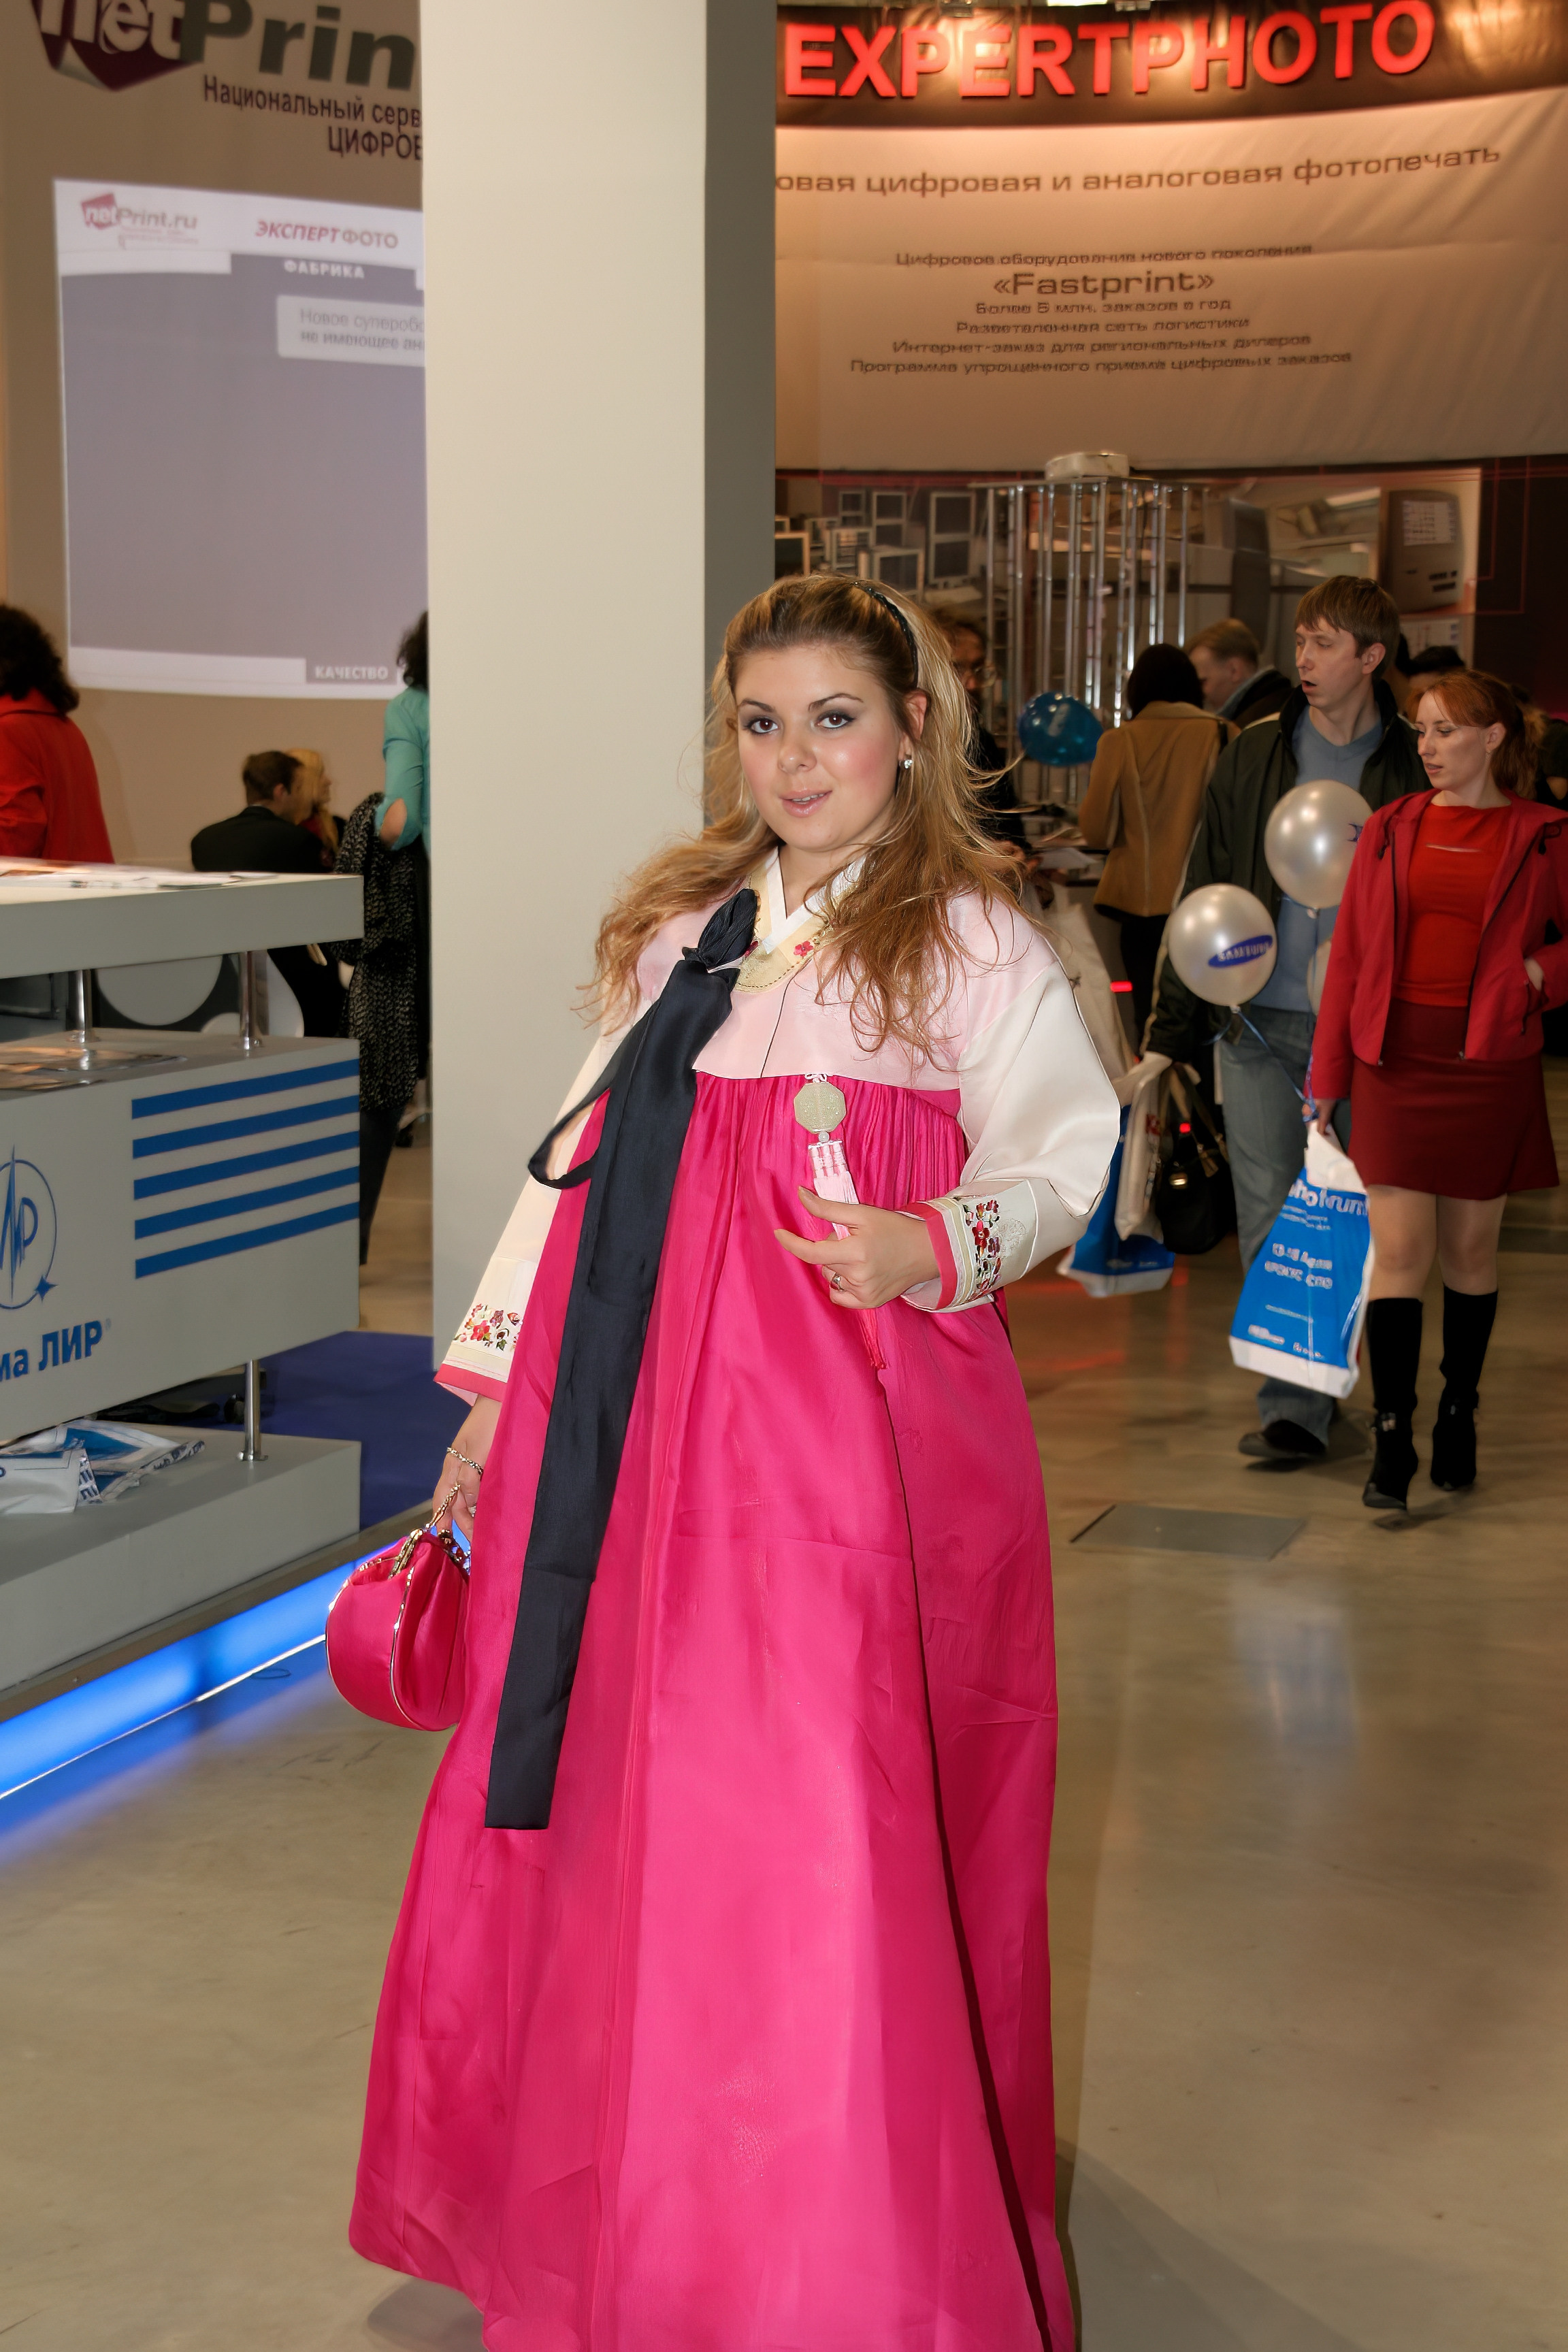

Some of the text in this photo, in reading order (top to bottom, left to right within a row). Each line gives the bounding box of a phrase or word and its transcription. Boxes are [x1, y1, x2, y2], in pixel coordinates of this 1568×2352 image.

[785, 0, 1435, 97] EXPERTPHOTO
[203, 74, 365, 122] Национальный
[866, 172, 1041, 198] цифровая
[1053, 176, 1071, 191] и
[1083, 166, 1282, 191] аналоговая
[1294, 147, 1501, 185] фотопечать
[283, 259, 365, 279] ФАБРИКА
[993, 270, 1215, 301] «Fastprint»
[38, 1320, 103, 1371] ЛИР
